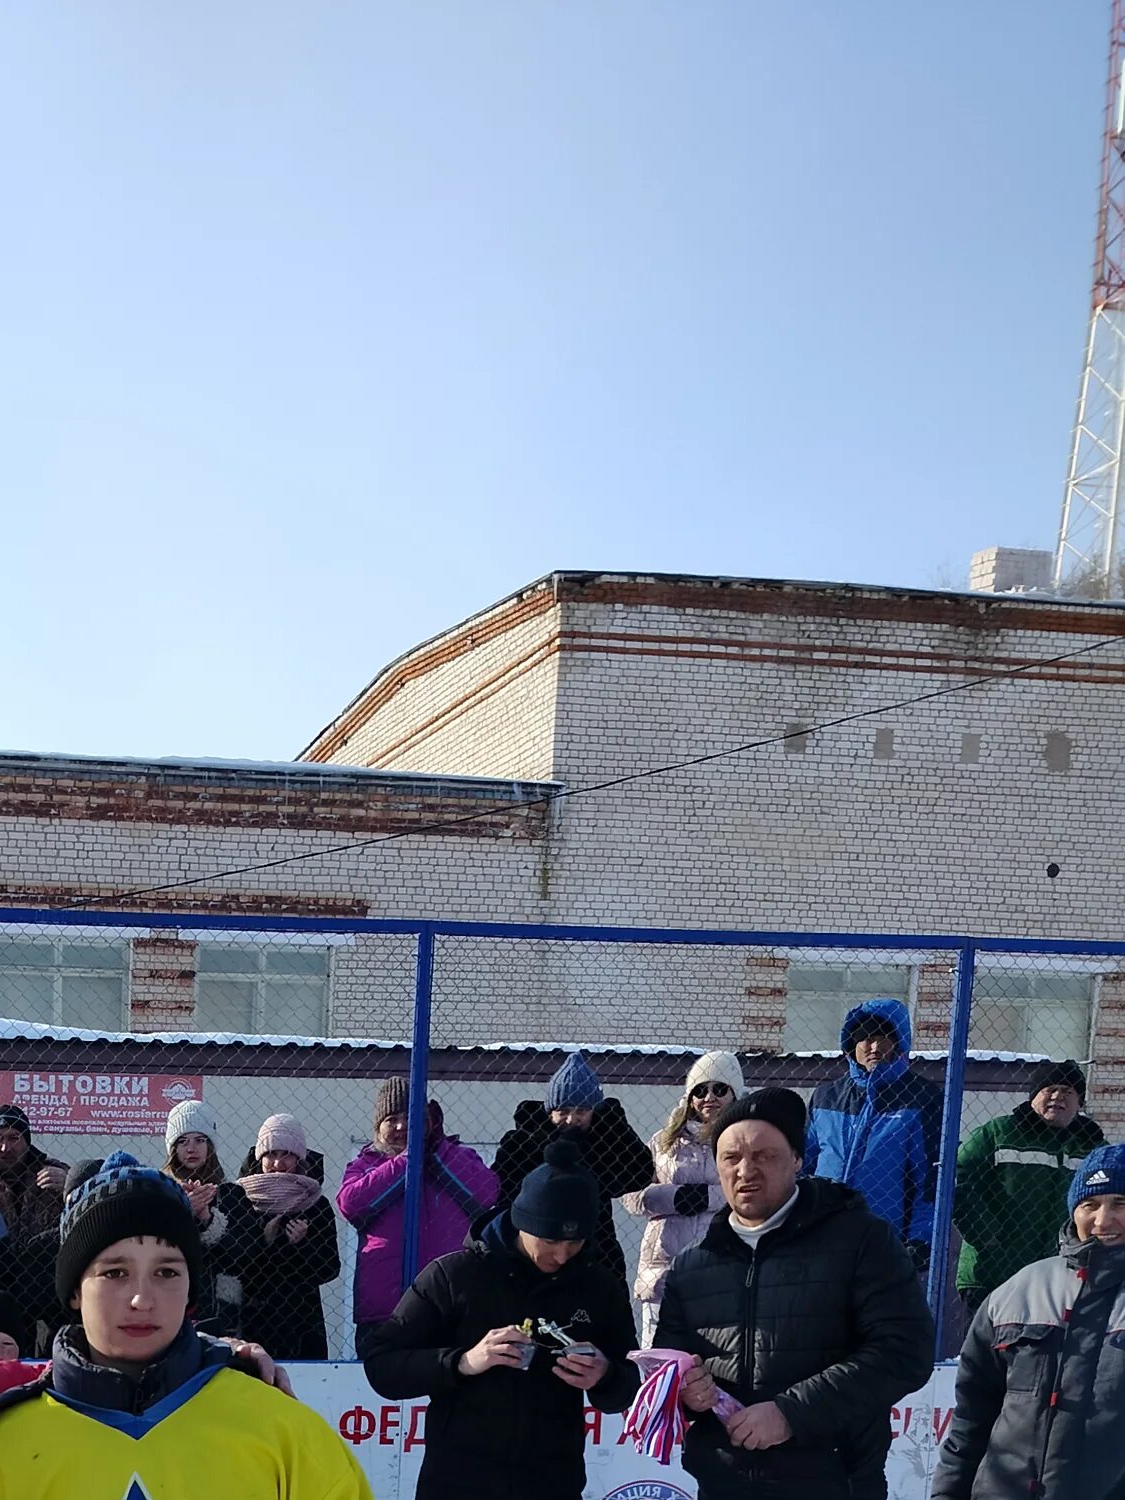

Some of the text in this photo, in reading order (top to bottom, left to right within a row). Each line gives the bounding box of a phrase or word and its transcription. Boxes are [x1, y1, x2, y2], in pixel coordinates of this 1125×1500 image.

[14, 1074, 148, 1094] БЫТОВКИ
[13, 1095, 68, 1105] АРЕНДА
[80, 1096, 149, 1107] ПРОДАЖА
